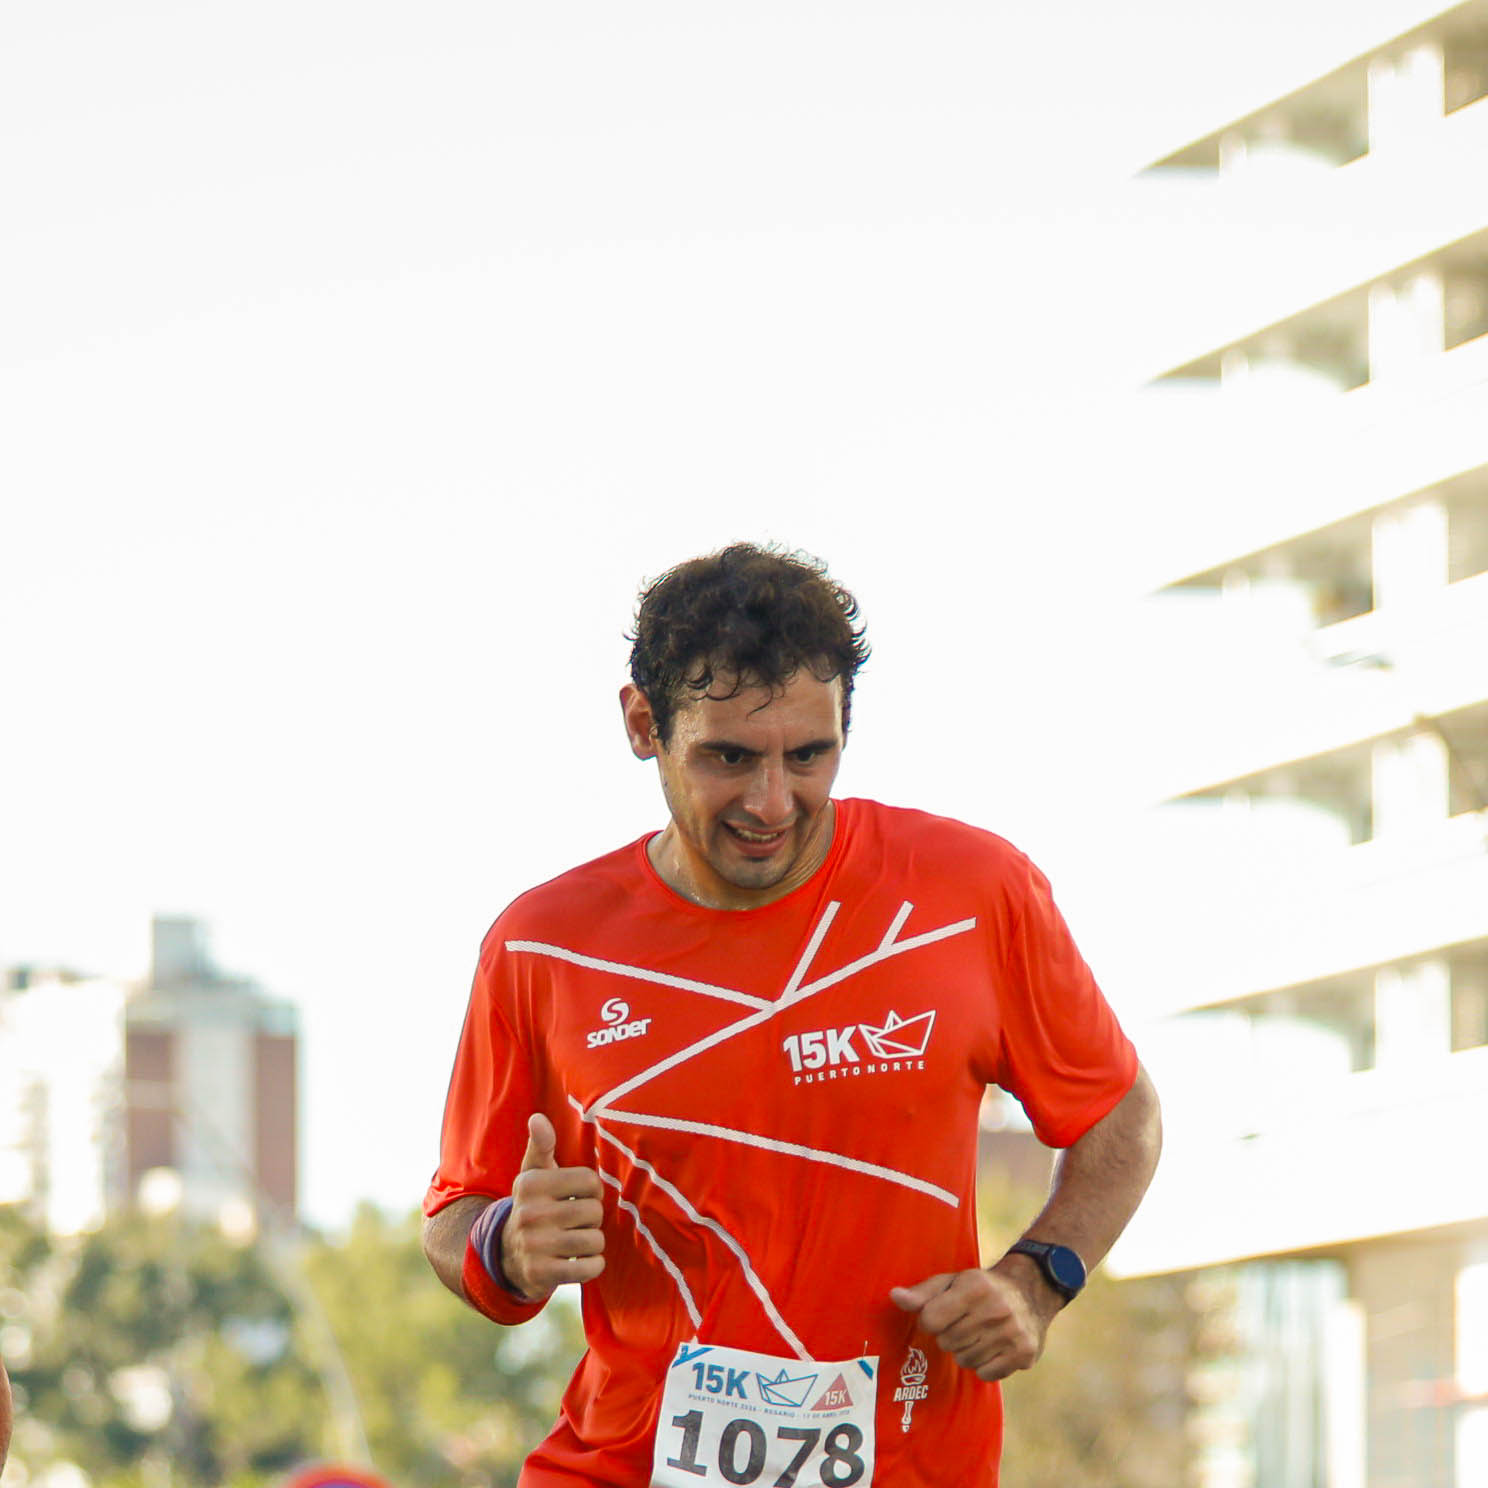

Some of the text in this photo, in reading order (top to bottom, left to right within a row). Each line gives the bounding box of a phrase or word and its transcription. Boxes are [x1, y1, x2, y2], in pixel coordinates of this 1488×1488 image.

[783, 1025, 860, 1072] 15K
[794, 1060, 925, 1085] PUERTO NORTE
[692, 1361, 751, 1399] 15K
[823, 1389, 847, 1406] 15K
[893, 1385, 929, 1402] ARDEC
